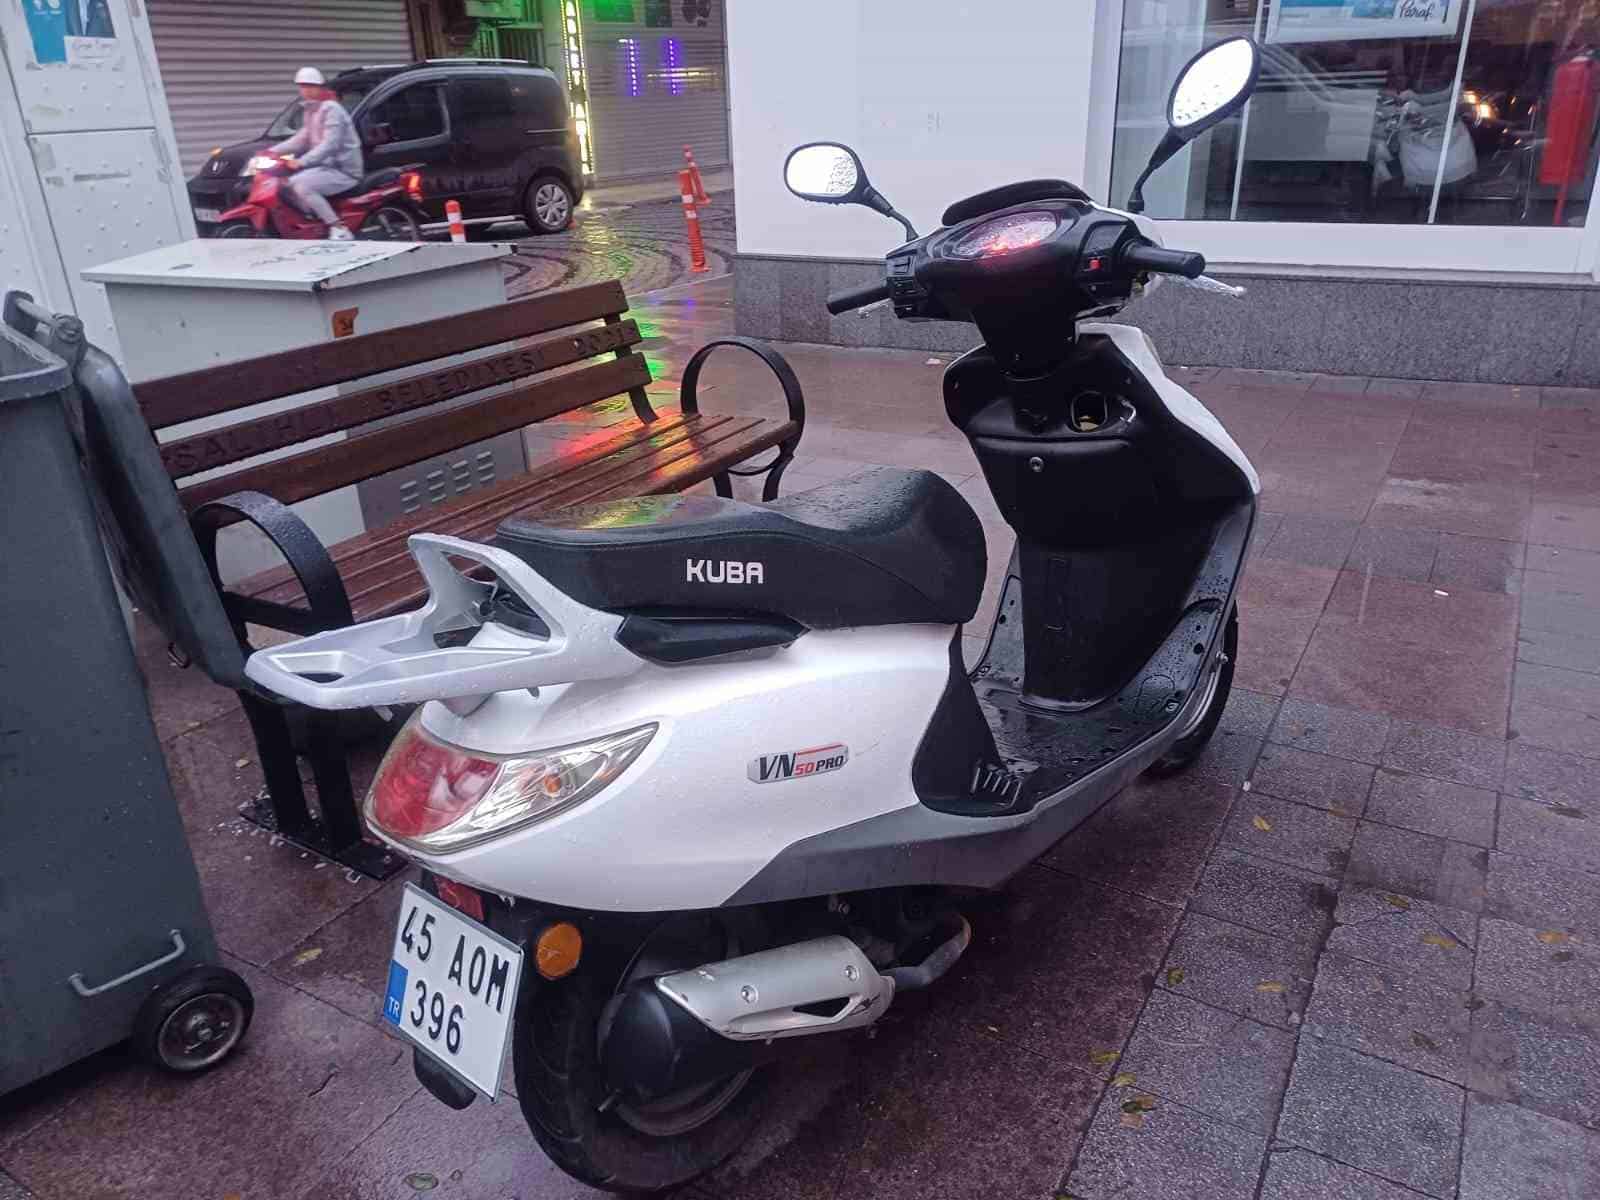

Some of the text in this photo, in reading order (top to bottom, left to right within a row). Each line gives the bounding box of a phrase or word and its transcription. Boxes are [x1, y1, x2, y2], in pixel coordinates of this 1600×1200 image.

[686, 559, 764, 584] KUBA
[401, 907, 509, 1012] 45 AOM
[387, 996, 401, 1018] TR
[411, 980, 463, 1054] 396
